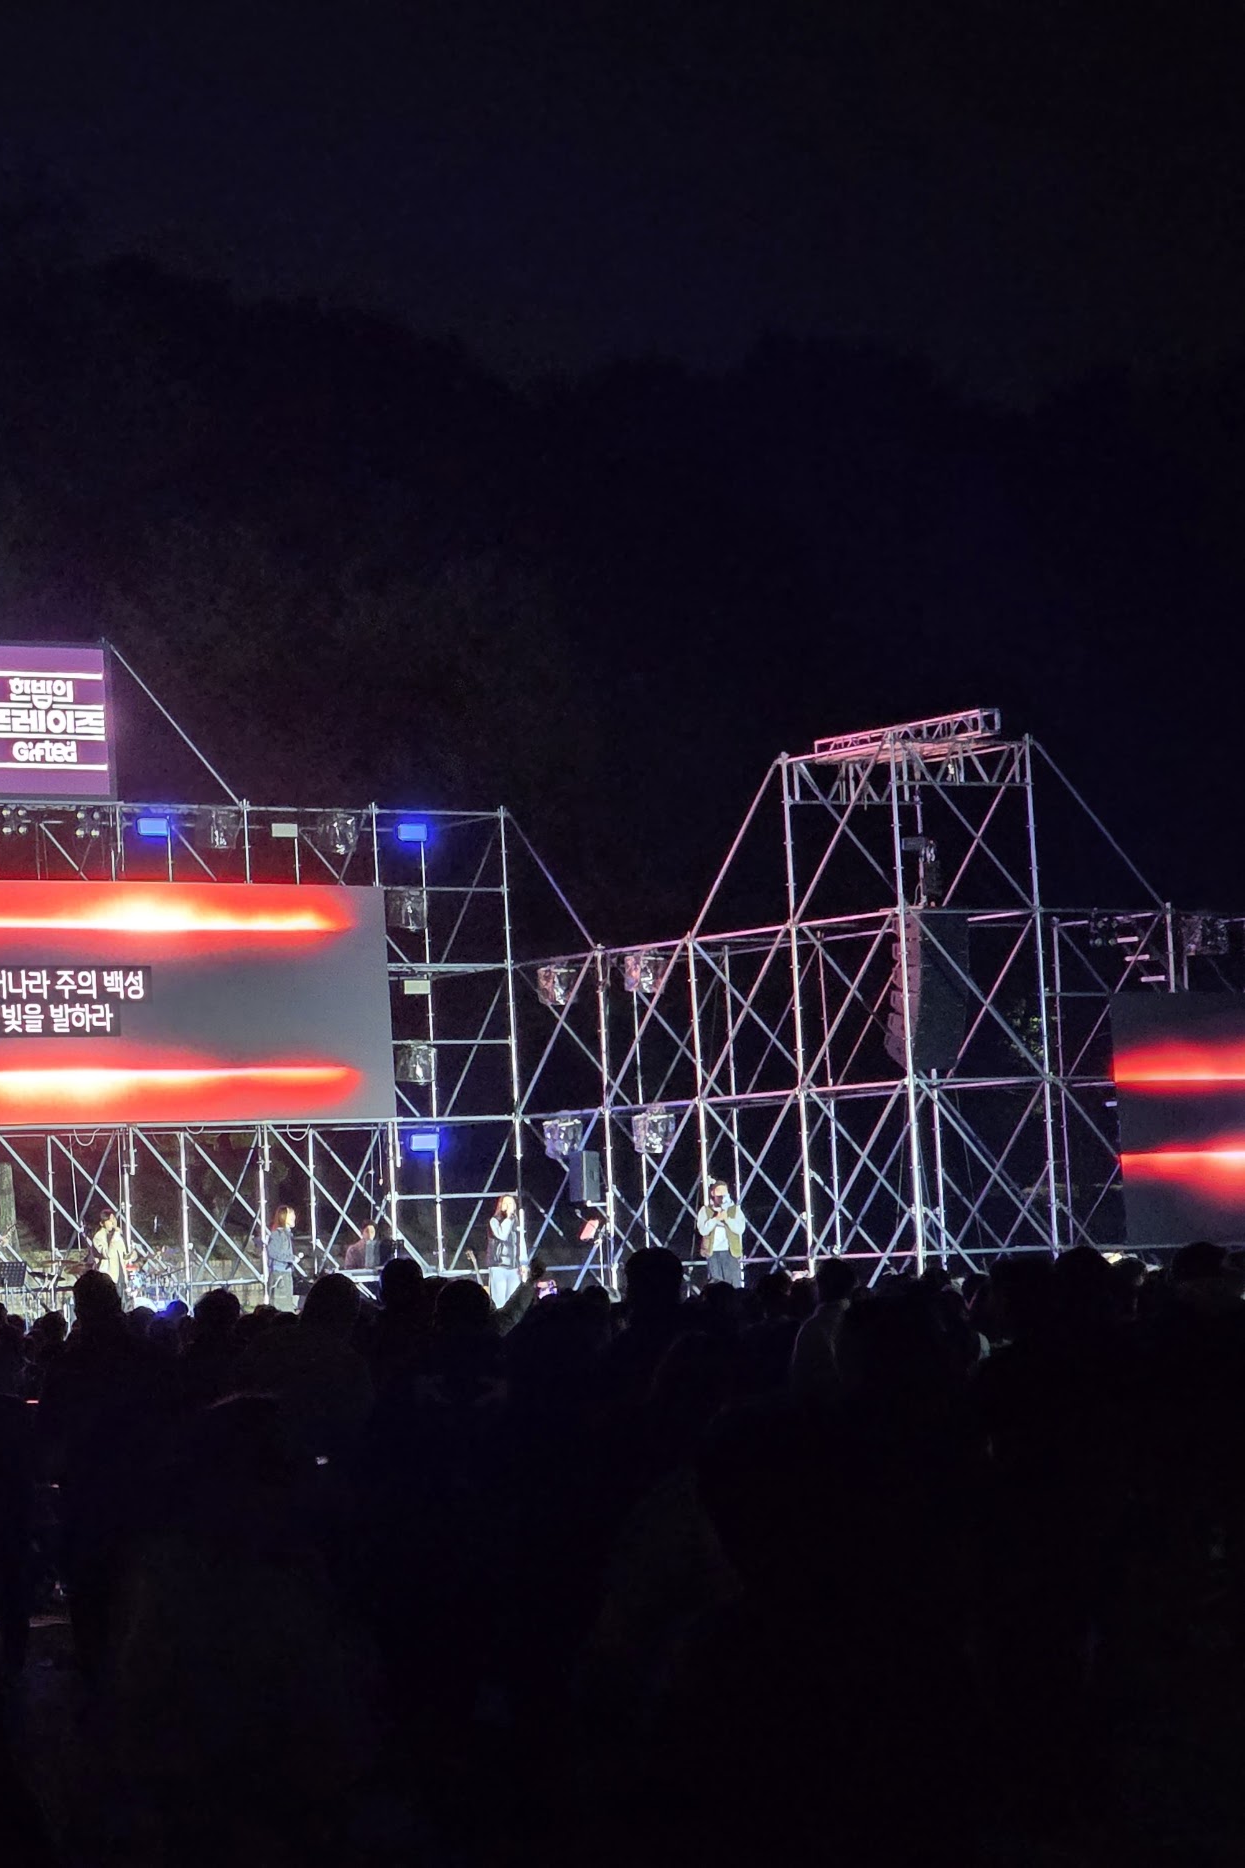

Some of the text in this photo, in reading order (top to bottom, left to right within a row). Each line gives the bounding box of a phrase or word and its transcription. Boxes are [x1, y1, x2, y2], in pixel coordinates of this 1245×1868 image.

[12, 740, 77, 763] Gifted
[55, 970, 97, 999] 주의
[102, 970, 145, 999] 백성
[1, 1003, 113, 1032] 빛을 발하라
